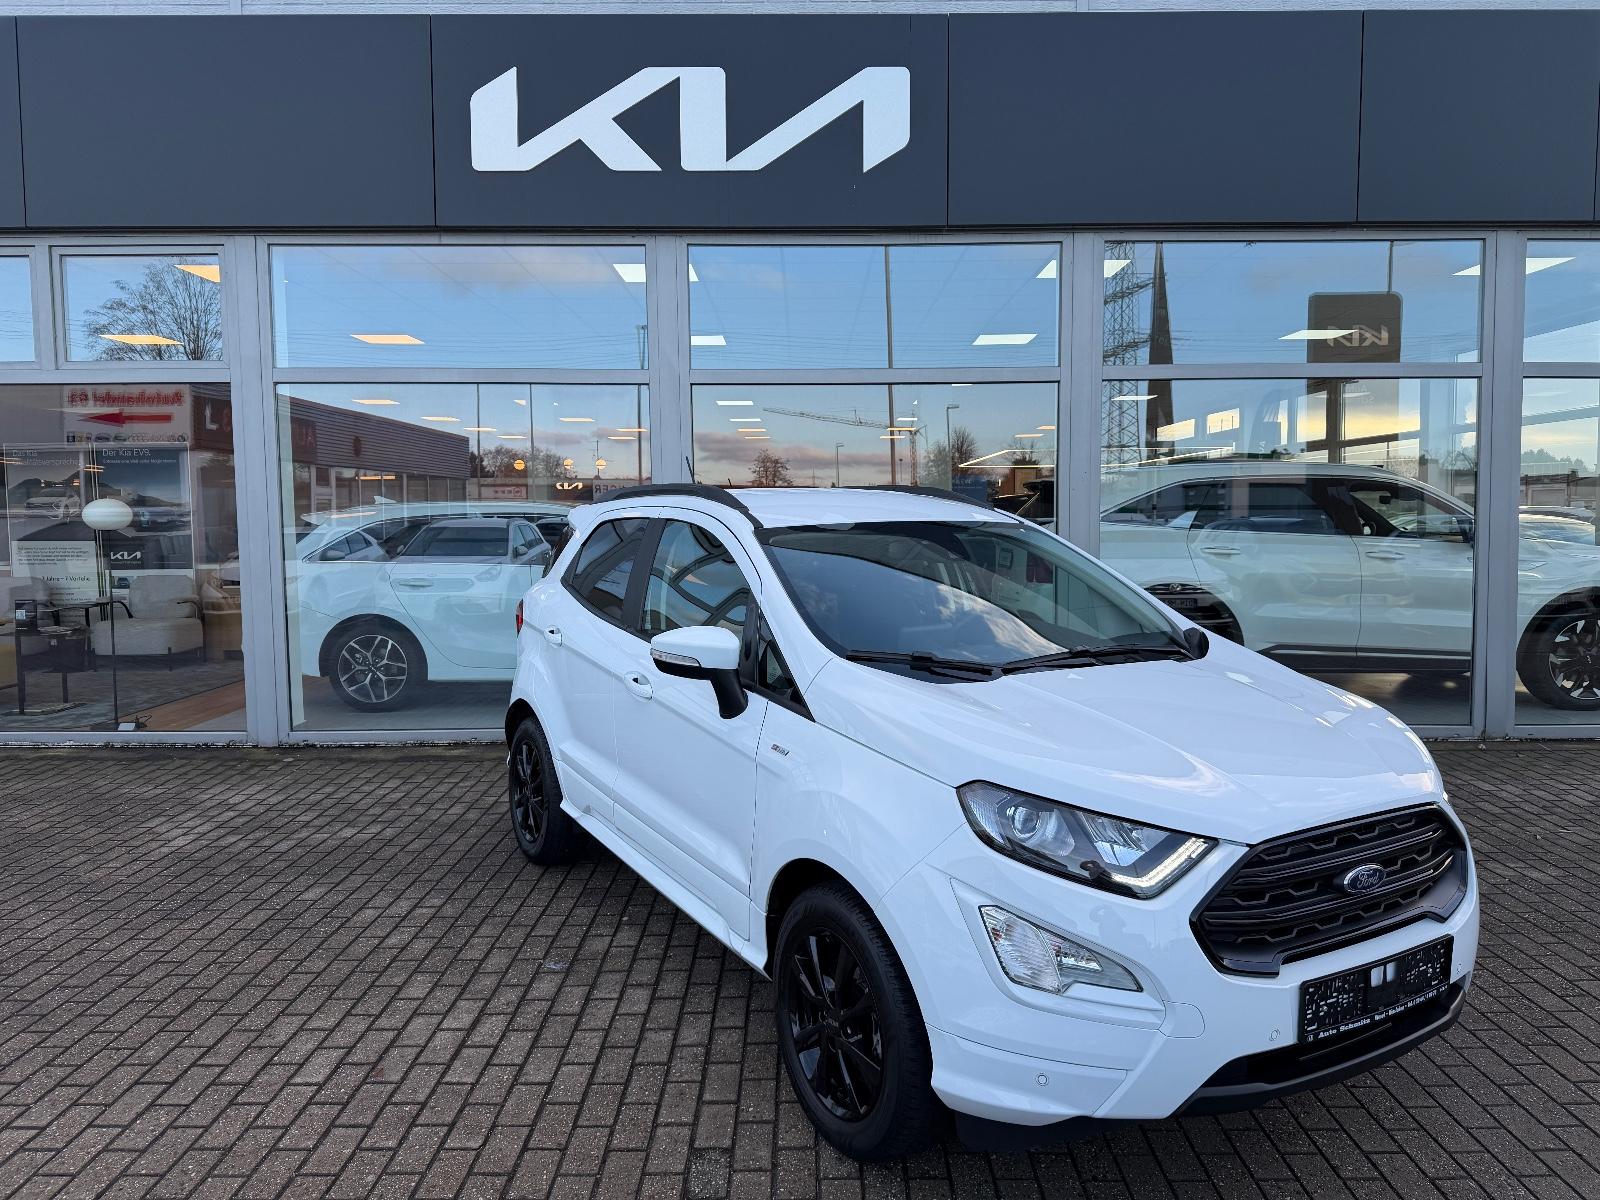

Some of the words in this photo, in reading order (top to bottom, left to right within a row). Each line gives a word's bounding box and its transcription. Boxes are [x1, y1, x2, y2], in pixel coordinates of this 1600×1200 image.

[470, 66, 910, 173] KIA
[110, 551, 142, 560] KIA
[1318, 1029, 1337, 1039] Auto
